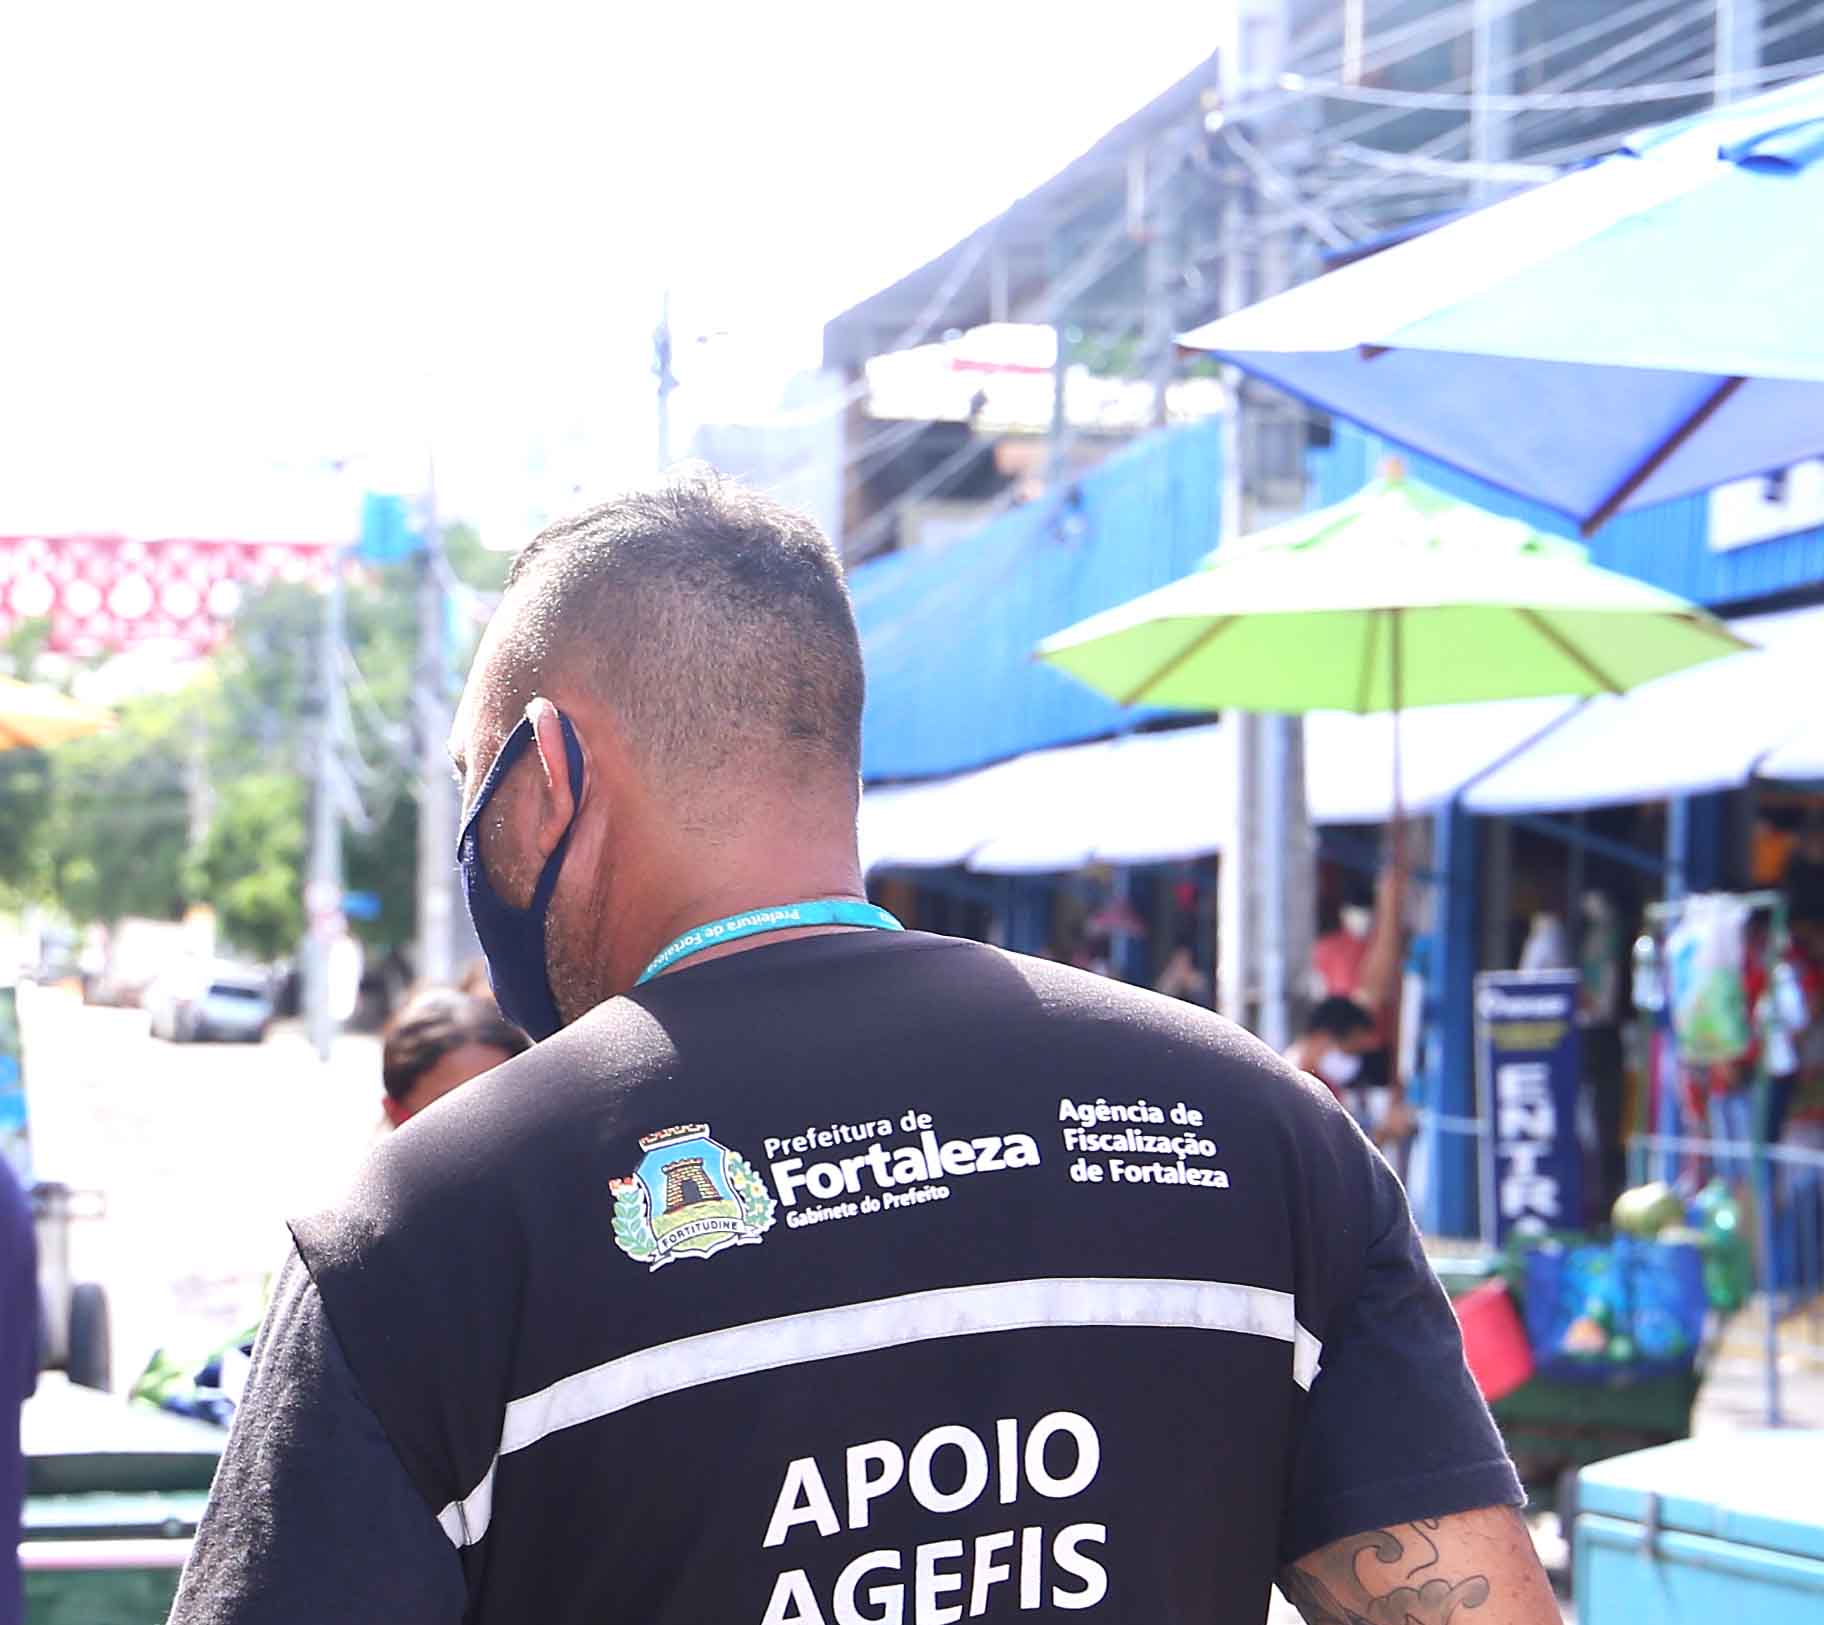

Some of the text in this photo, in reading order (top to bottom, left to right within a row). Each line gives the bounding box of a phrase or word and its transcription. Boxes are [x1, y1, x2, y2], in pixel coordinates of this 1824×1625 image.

[705, 924, 725, 937] de
[1059, 1098, 1204, 1128] Agência de
[764, 1109, 933, 1159] Prefeitura de
[1063, 1127, 1217, 1160] Fiscalização
[770, 1130, 1041, 1207] Fortaleza
[1070, 1157, 1230, 1188] de Fortaleza
[785, 1185, 951, 1229] Gabinete do Prefeito
[661, 1220, 739, 1248] FORTITUDINE
[762, 1411, 1101, 1548] APOIO
